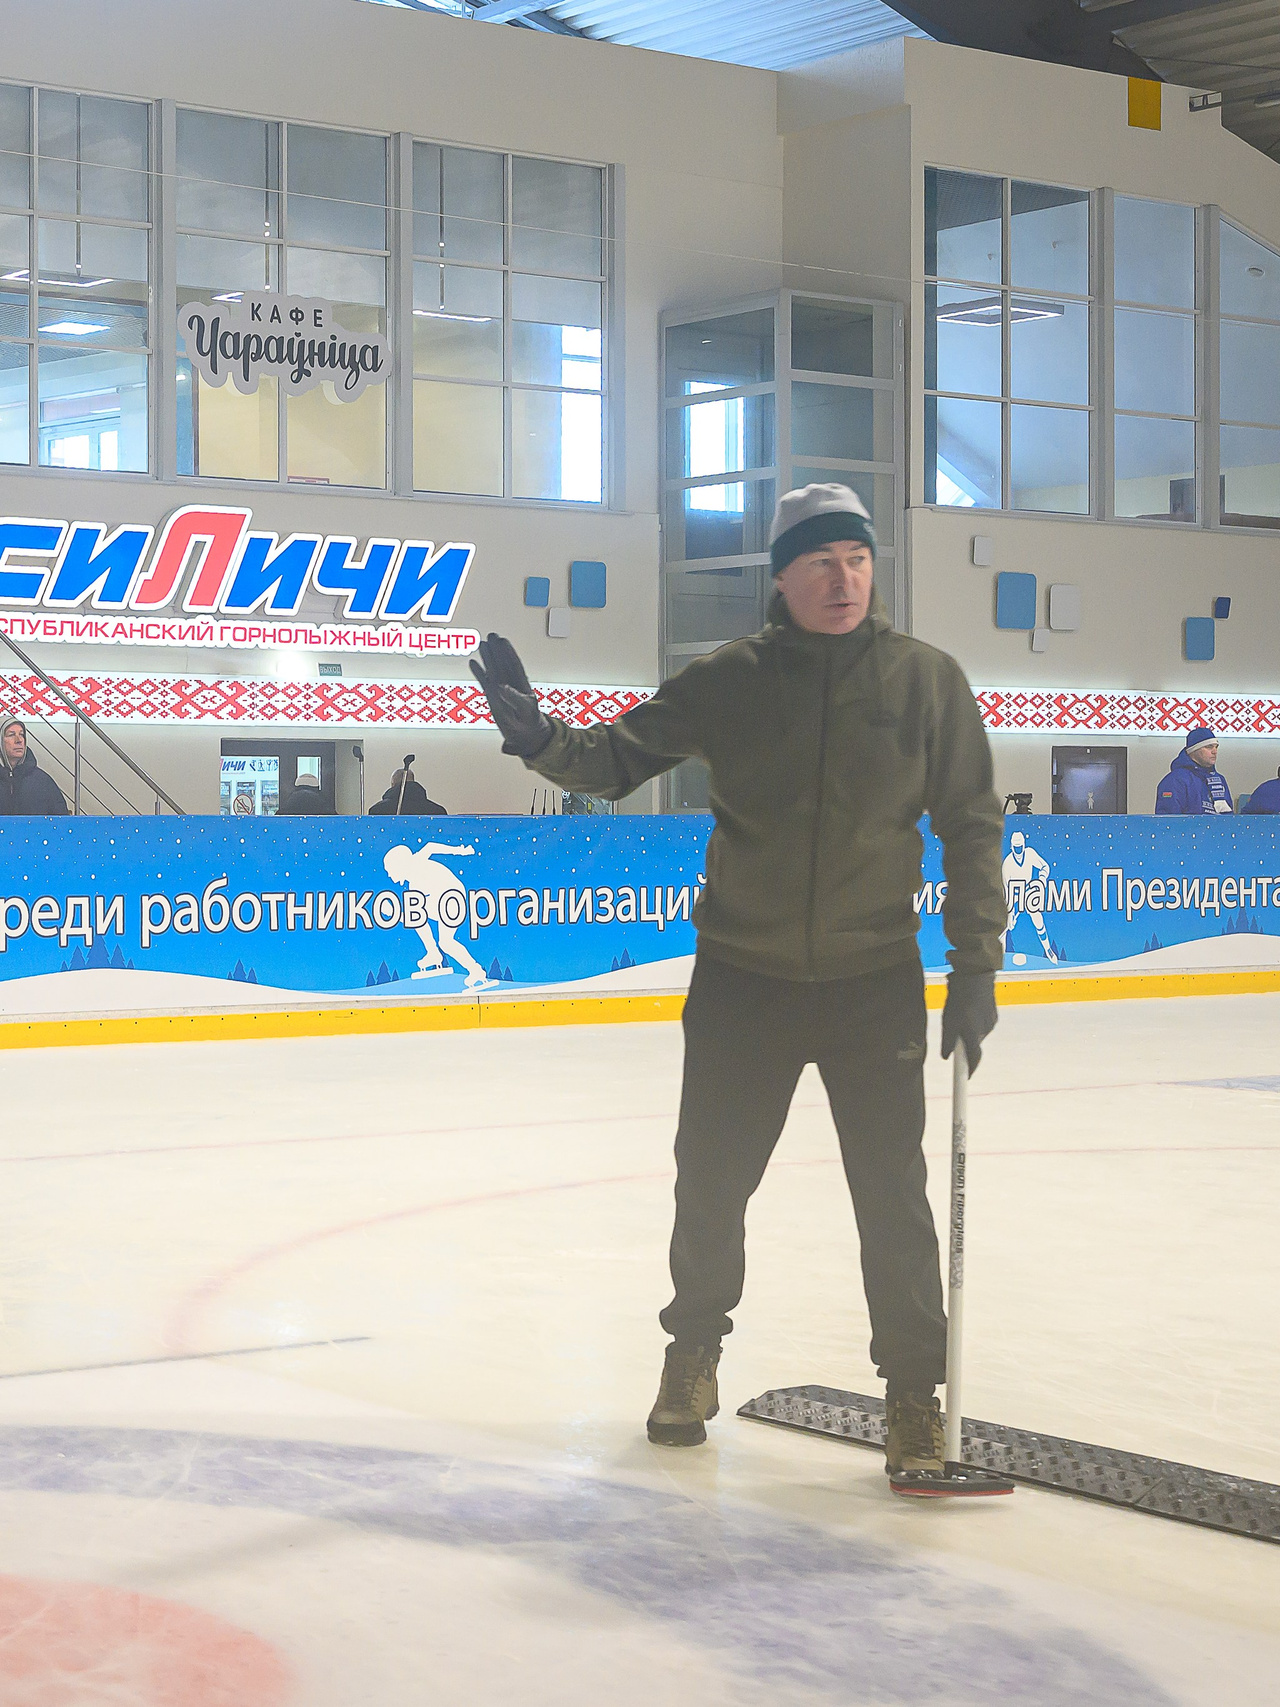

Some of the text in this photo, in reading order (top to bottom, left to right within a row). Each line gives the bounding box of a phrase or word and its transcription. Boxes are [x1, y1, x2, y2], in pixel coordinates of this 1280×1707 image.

[250, 302, 323, 328] КАФЕ
[187, 314, 384, 390] Чараўніца
[220, 626, 402, 648] ГОРНОЛЫЖНЫЙ
[408, 632, 477, 651] ЦЕНТР
[140, 877, 429, 948] работников
[1006, 879, 1092, 913] лами
[1101, 867, 1280, 922] Президента
